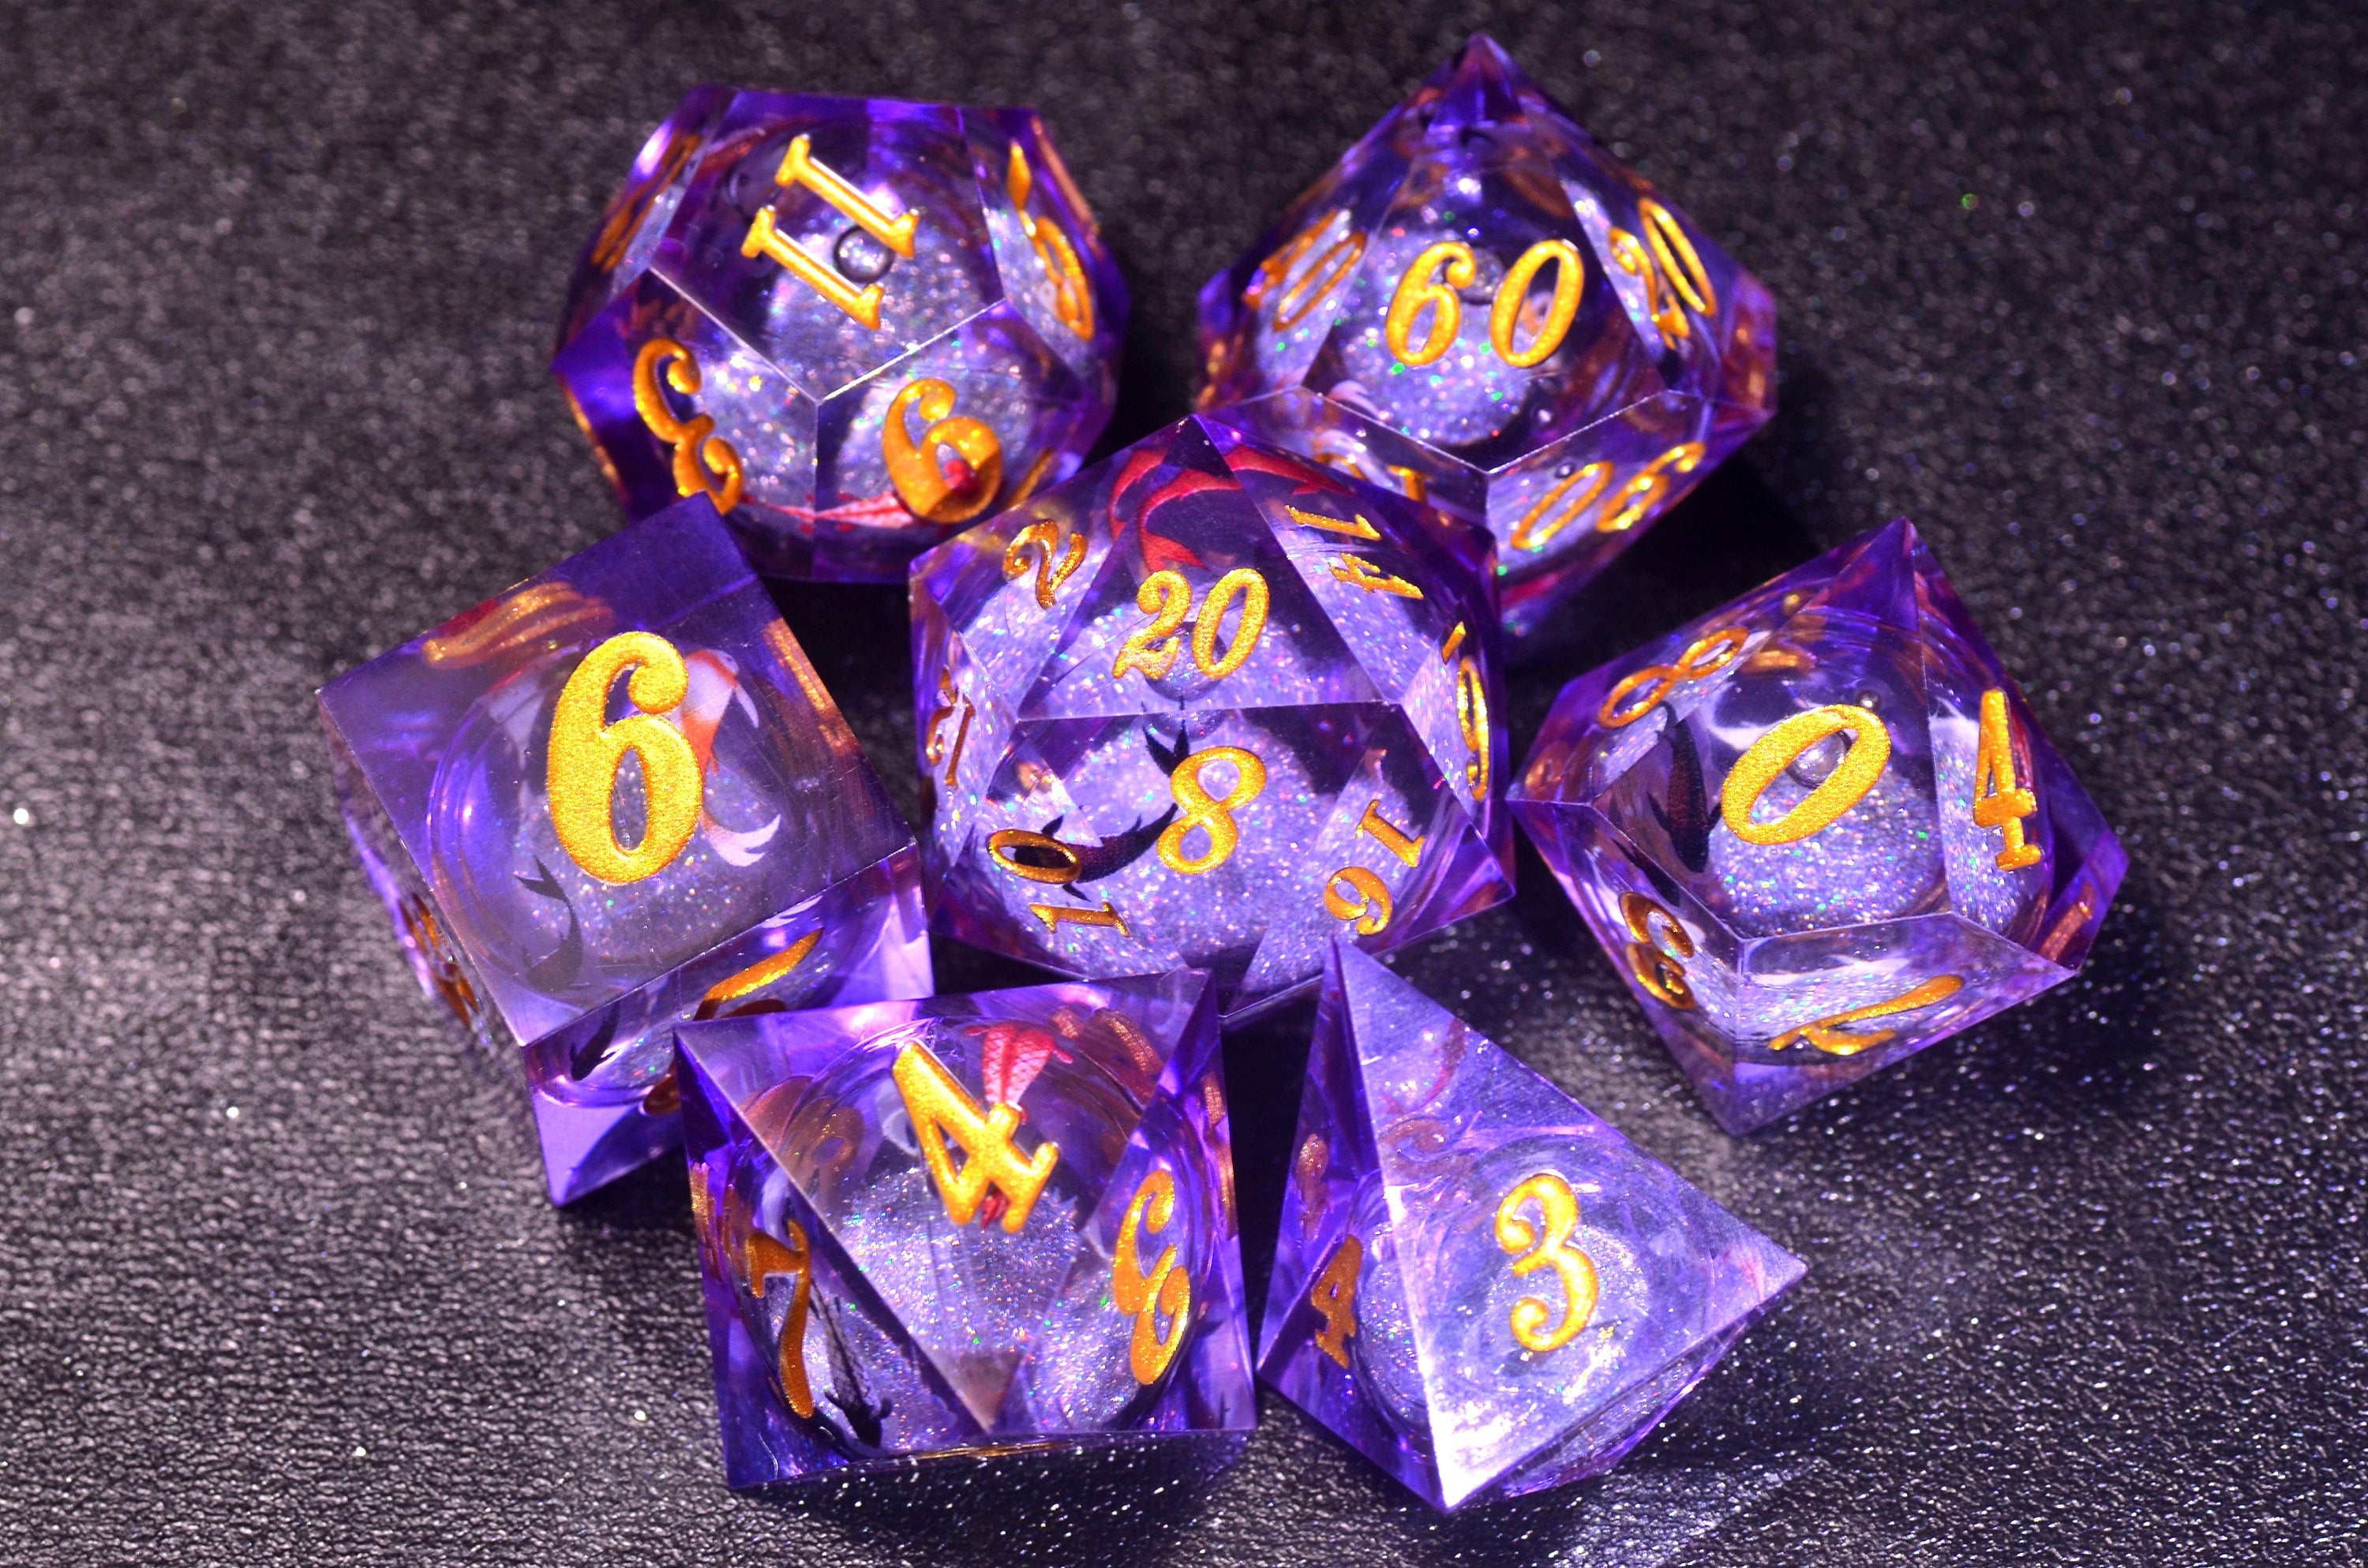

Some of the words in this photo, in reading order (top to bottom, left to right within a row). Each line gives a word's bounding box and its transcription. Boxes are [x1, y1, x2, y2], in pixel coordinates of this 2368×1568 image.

[741, 134, 920, 329] 11
[1385, 239, 1584, 368] 60
[1609, 197, 1718, 350] 20
[1003, 518, 1088, 610] 2
[1112, 567, 1270, 681] 20
[1597, 626, 1749, 728] 8
[545, 631, 703, 886] 6
[1157, 746, 1267, 874] 8
[1721, 704, 1891, 846] 0
[1973, 687, 2042, 871] 4
[892, 1041, 1060, 1233] 4
[745, 1218, 815, 1419] 7
[1495, 1173, 1599, 1352] 3
